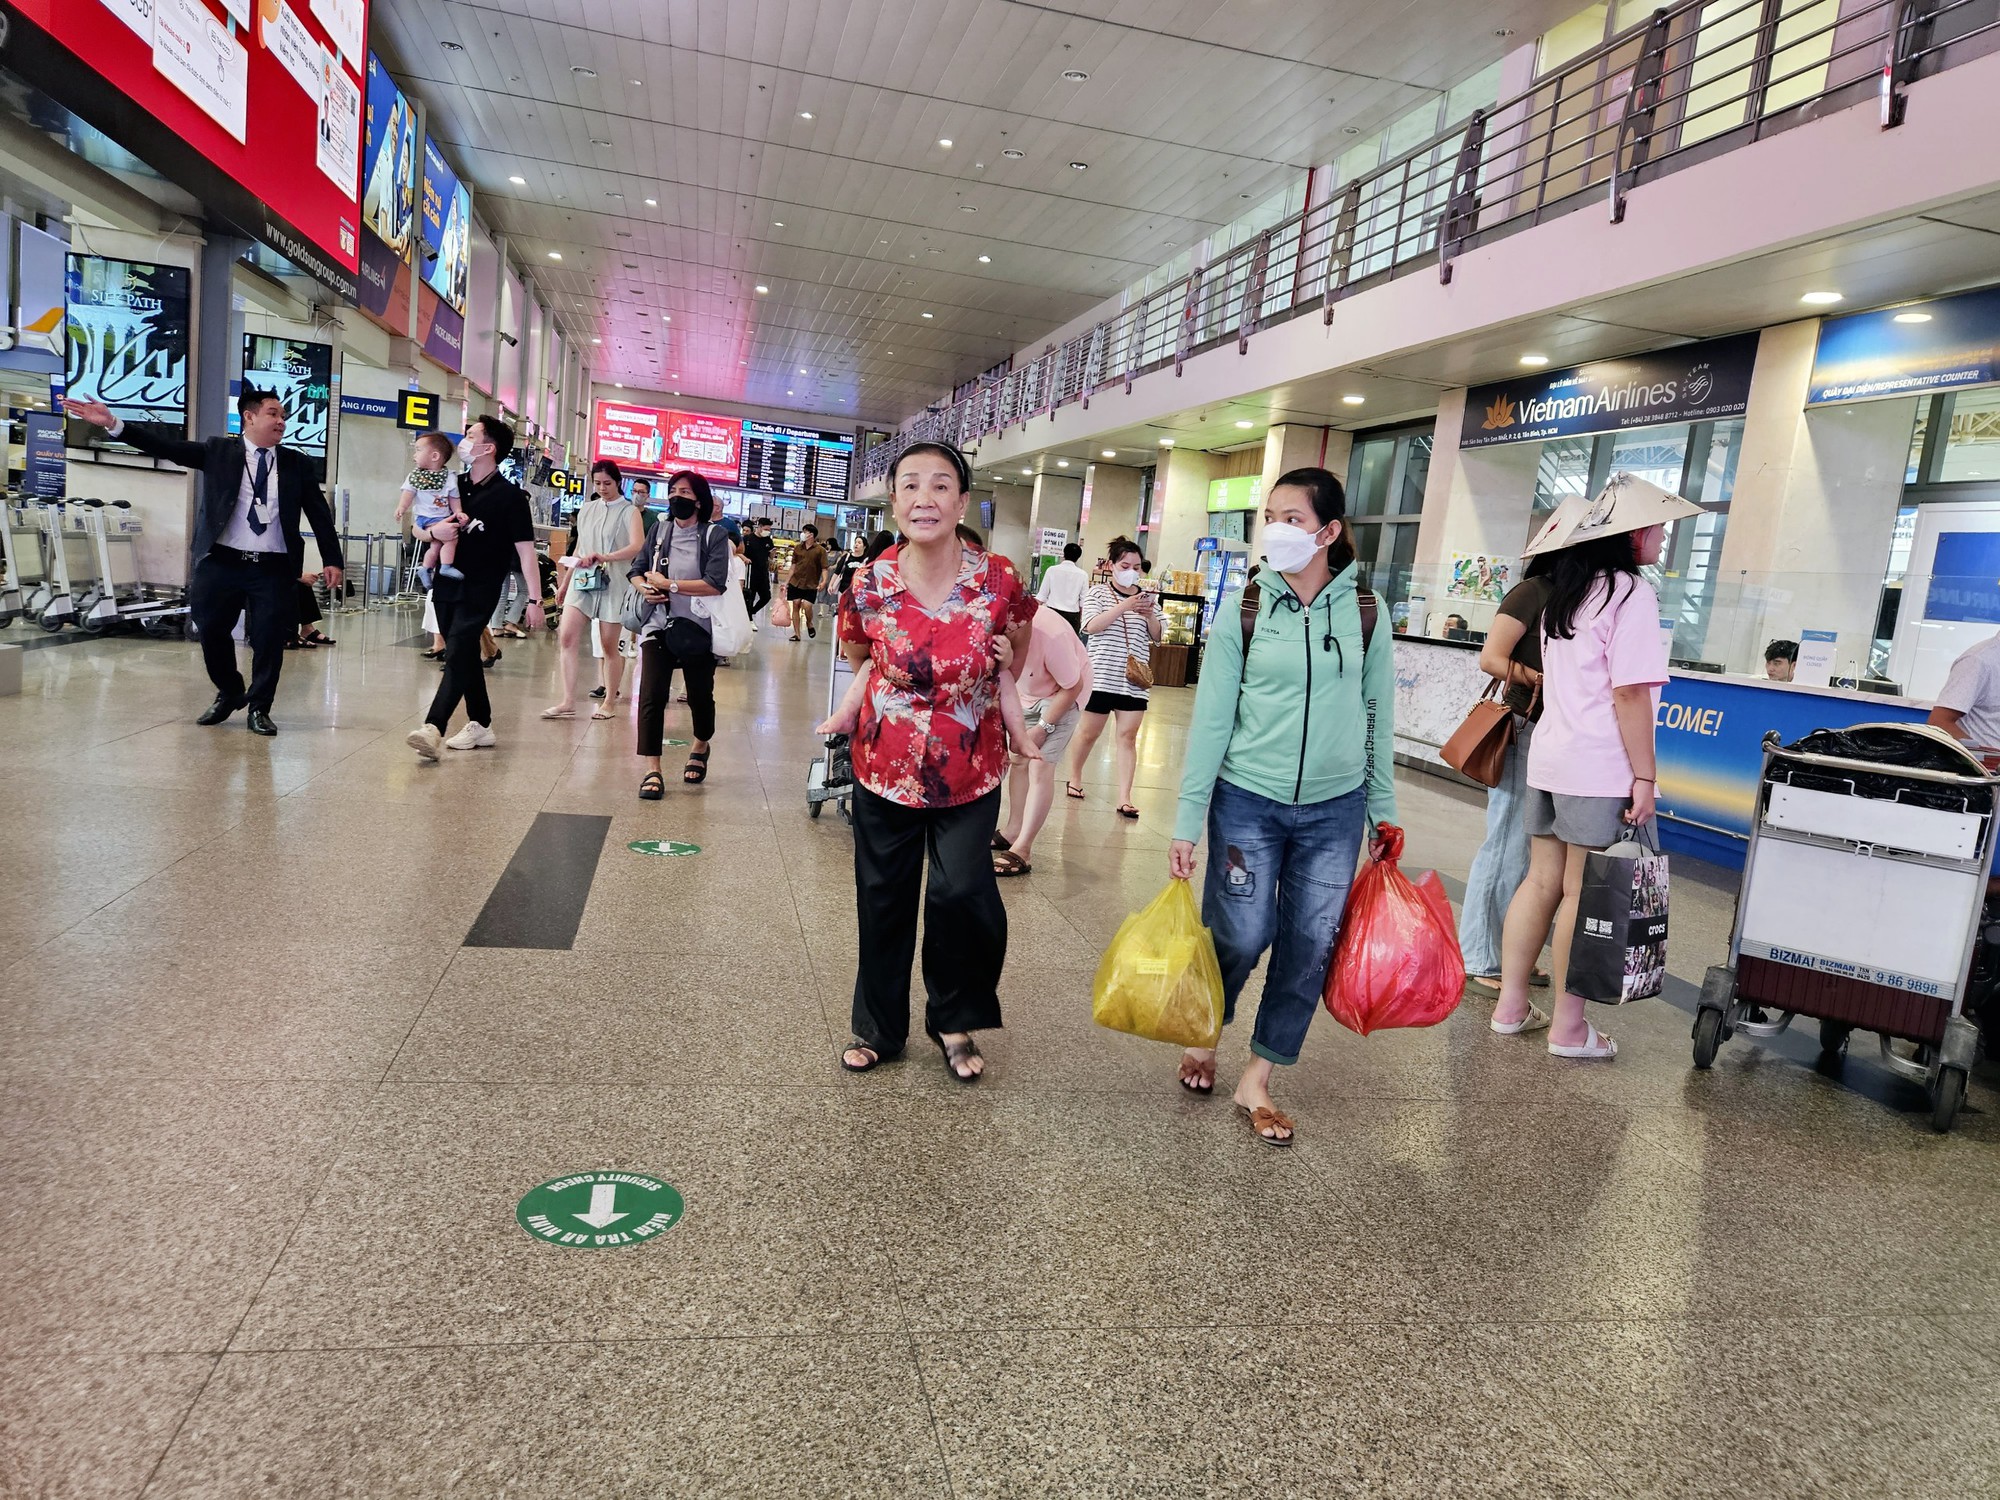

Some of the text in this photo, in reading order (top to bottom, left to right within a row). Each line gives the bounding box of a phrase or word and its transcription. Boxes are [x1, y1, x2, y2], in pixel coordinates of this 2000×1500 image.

[266, 222, 357, 298] www.goldsungroup.com.vn
[126, 294, 162, 309] PATH
[286, 362, 312, 375] PATH
[1940, 370, 1979, 382] COUNTER
[366, 404, 386, 413] ROW
[1519, 380, 1677, 424] Vietnam Airlines
[405, 396, 430, 426] E
[1683, 409, 1704, 417] Hotline:
[1706, 406, 1720, 414] 0903
[1721, 404, 1732, 412] 020
[1734, 403, 1745, 411] 020
[752, 423, 774, 433] Chuyến
[786, 428, 819, 438] Departures
[551, 470, 566, 487] G
[570, 480, 582, 493] H
[1367, 699, 1376, 710] UV
[1648, 922, 1666, 936] crocs
[1820, 960, 1855, 972] BIZMAN
[1888, 975, 1903, 987] 86
[1907, 979, 1938, 994] 9898
[546, 1173, 662, 1192] SECURITY CHECK
[527, 1214, 562, 1237] NINH
[560, 1232, 589, 1244] AN
[595, 1232, 633, 1245] TRA
